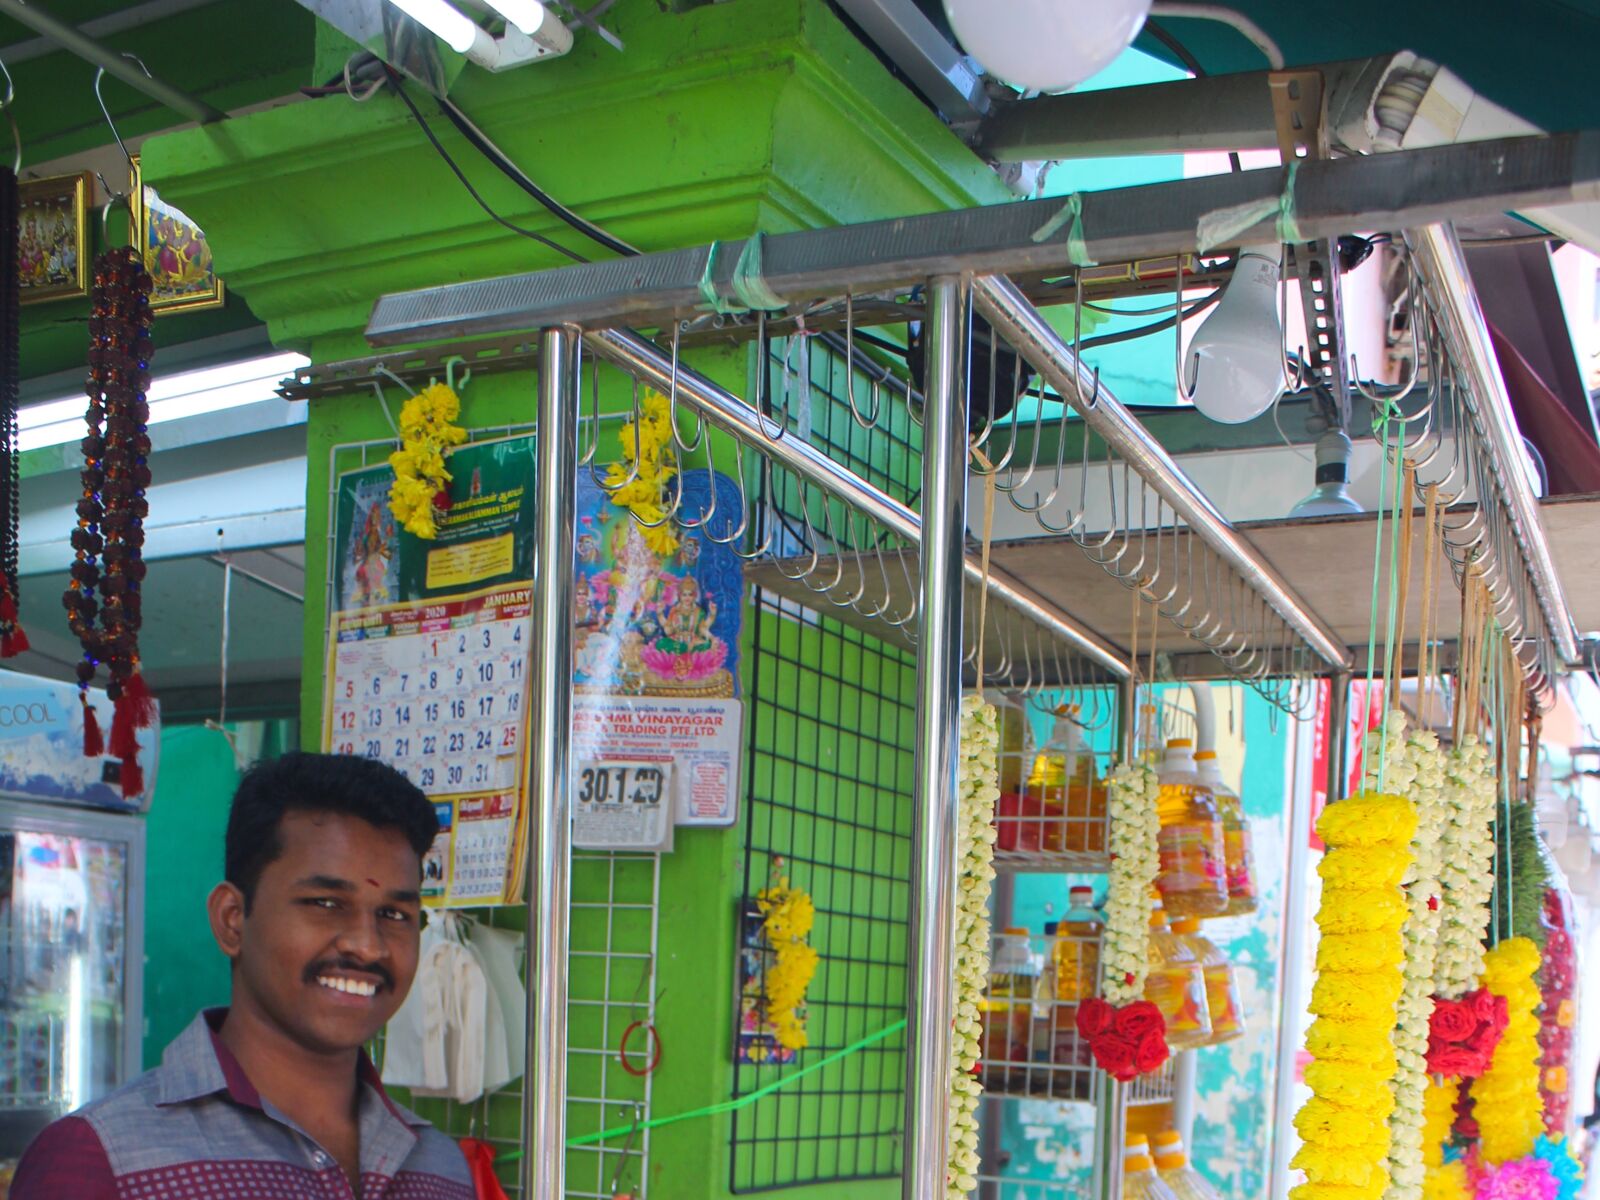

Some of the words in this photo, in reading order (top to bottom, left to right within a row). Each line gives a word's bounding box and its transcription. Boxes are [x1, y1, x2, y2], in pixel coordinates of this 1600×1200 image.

[483, 590, 532, 608] JANUARY
[425, 606, 446, 618] 2020
[432, 639, 438, 657] 1
[459, 634, 466, 653] 2
[483, 629, 491, 648] 3
[514, 624, 521, 643] 4
[346, 680, 354, 698] 5
[373, 677, 381, 695] 6
[401, 674, 409, 692] 7
[430, 671, 437, 689] 8
[456, 667, 463, 685] 9
[479, 663, 493, 682] 10
[510, 659, 522, 679] 11
[0, 702, 57, 728] COOL
[341, 711, 355, 729] 12
[369, 708, 382, 727] 13
[396, 705, 410, 724] 14
[425, 703, 438, 721] 15
[451, 700, 465, 719] 16
[479, 696, 494, 716] 17
[508, 693, 519, 712] 18
[574, 713, 632, 723] AKSHMI
[637, 713, 724, 726] VINAYAGAR
[613, 724, 667, 735] TRADING
[339, 742, 353, 757] 19
[367, 740, 381, 758] 20
[396, 738, 409, 757] 21
[423, 736, 436, 754] 22
[449, 733, 464, 752] 23
[477, 730, 492, 749] 24
[503, 726, 516, 746] 25
[421, 768, 435, 786] 29
[448, 766, 463, 784] 30
[476, 763, 488, 782] 31
